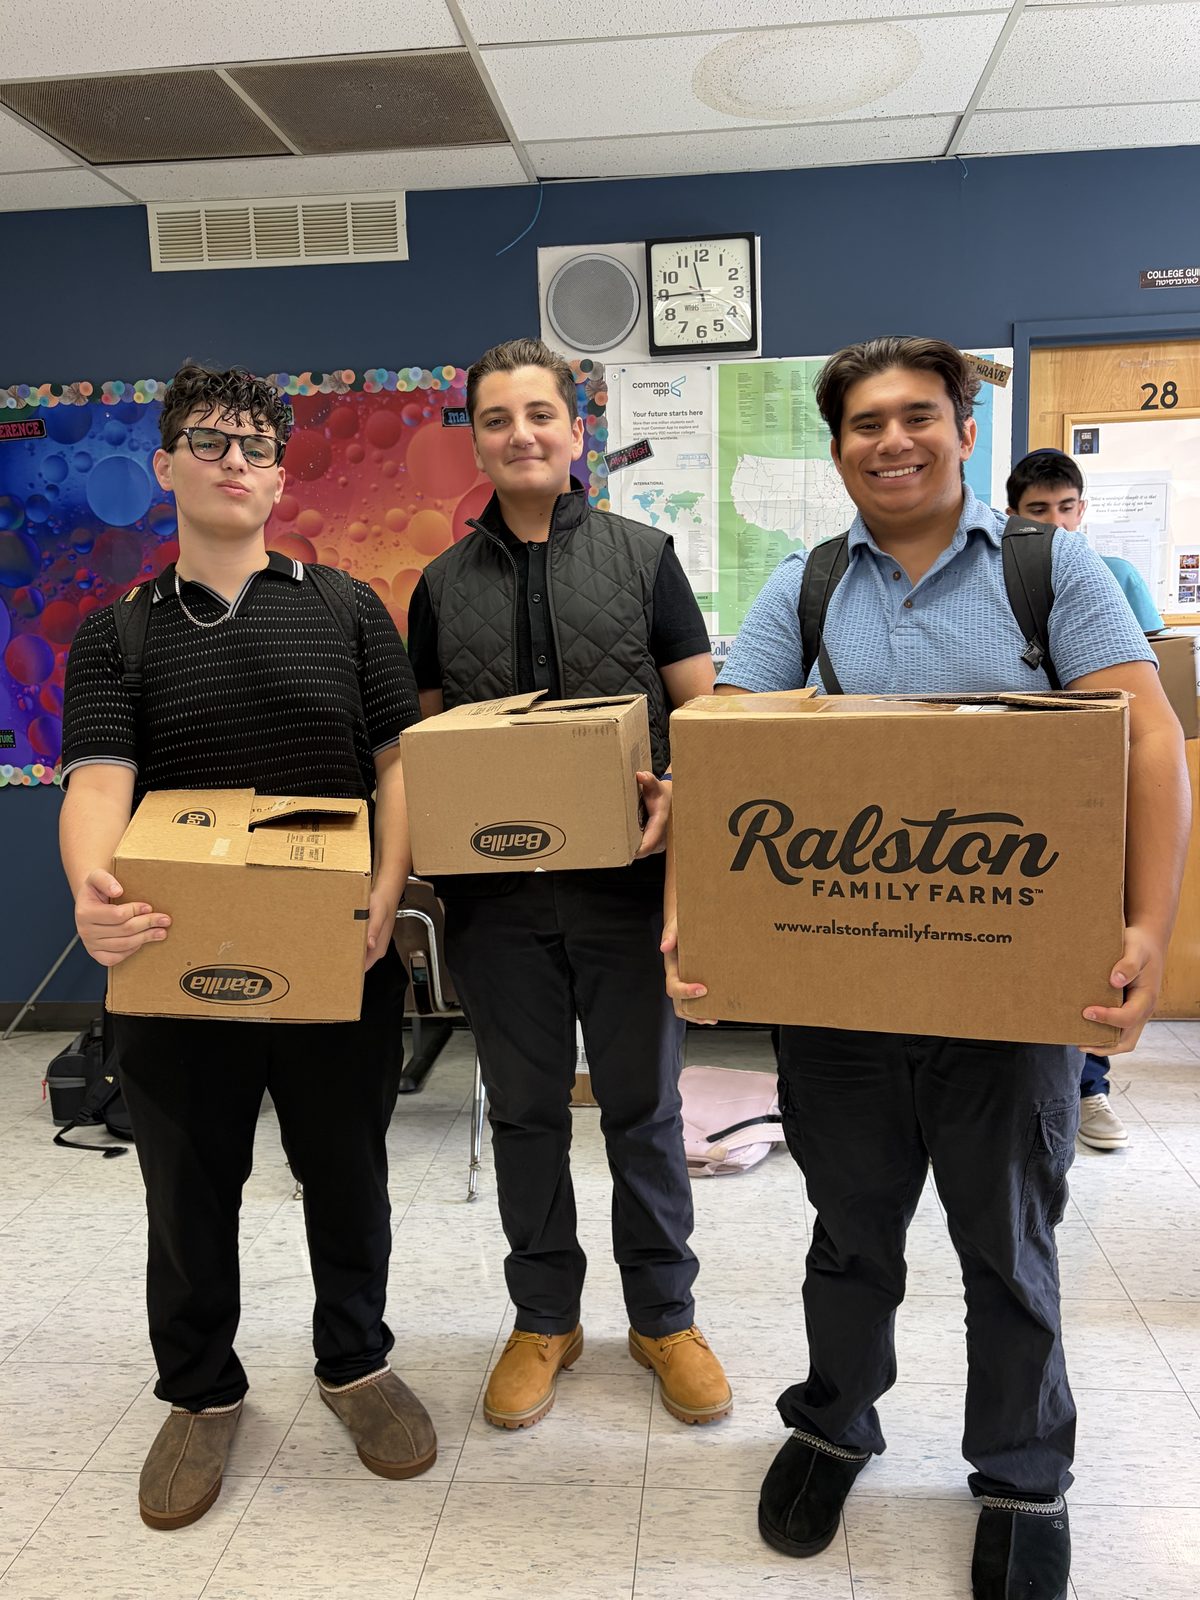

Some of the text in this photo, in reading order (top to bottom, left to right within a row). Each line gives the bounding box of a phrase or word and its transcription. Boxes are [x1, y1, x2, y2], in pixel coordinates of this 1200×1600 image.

[678, 256, 688, 268] 11
[694, 249, 709, 262] 12
[719, 254, 723, 266] 1
[663, 271, 678, 284] 10
[728, 268, 738, 280] 2
[1147, 270, 1184, 279] COLLEGE
[658, 289, 670, 302] 9
[733, 286, 744, 298] 3
[664, 308, 676, 320] 8
[726, 306, 738, 318] 4
[678, 321, 688, 333] 7
[696, 326, 707, 338] 6
[713, 319, 724, 332] 5
[976, 364, 1006, 382] BRAVE
[653, 388, 670, 397] app
[1140, 381, 1178, 410] 28
[448, 411, 469, 424] ma
[480, 833, 543, 852] Barilla
[728, 799, 1060, 886] Ralston
[812, 880, 920, 900] FAMILY
[774, 920, 1012, 944] www.ralstonfamilyfarms.com
[190, 976, 264, 996] Barilla
